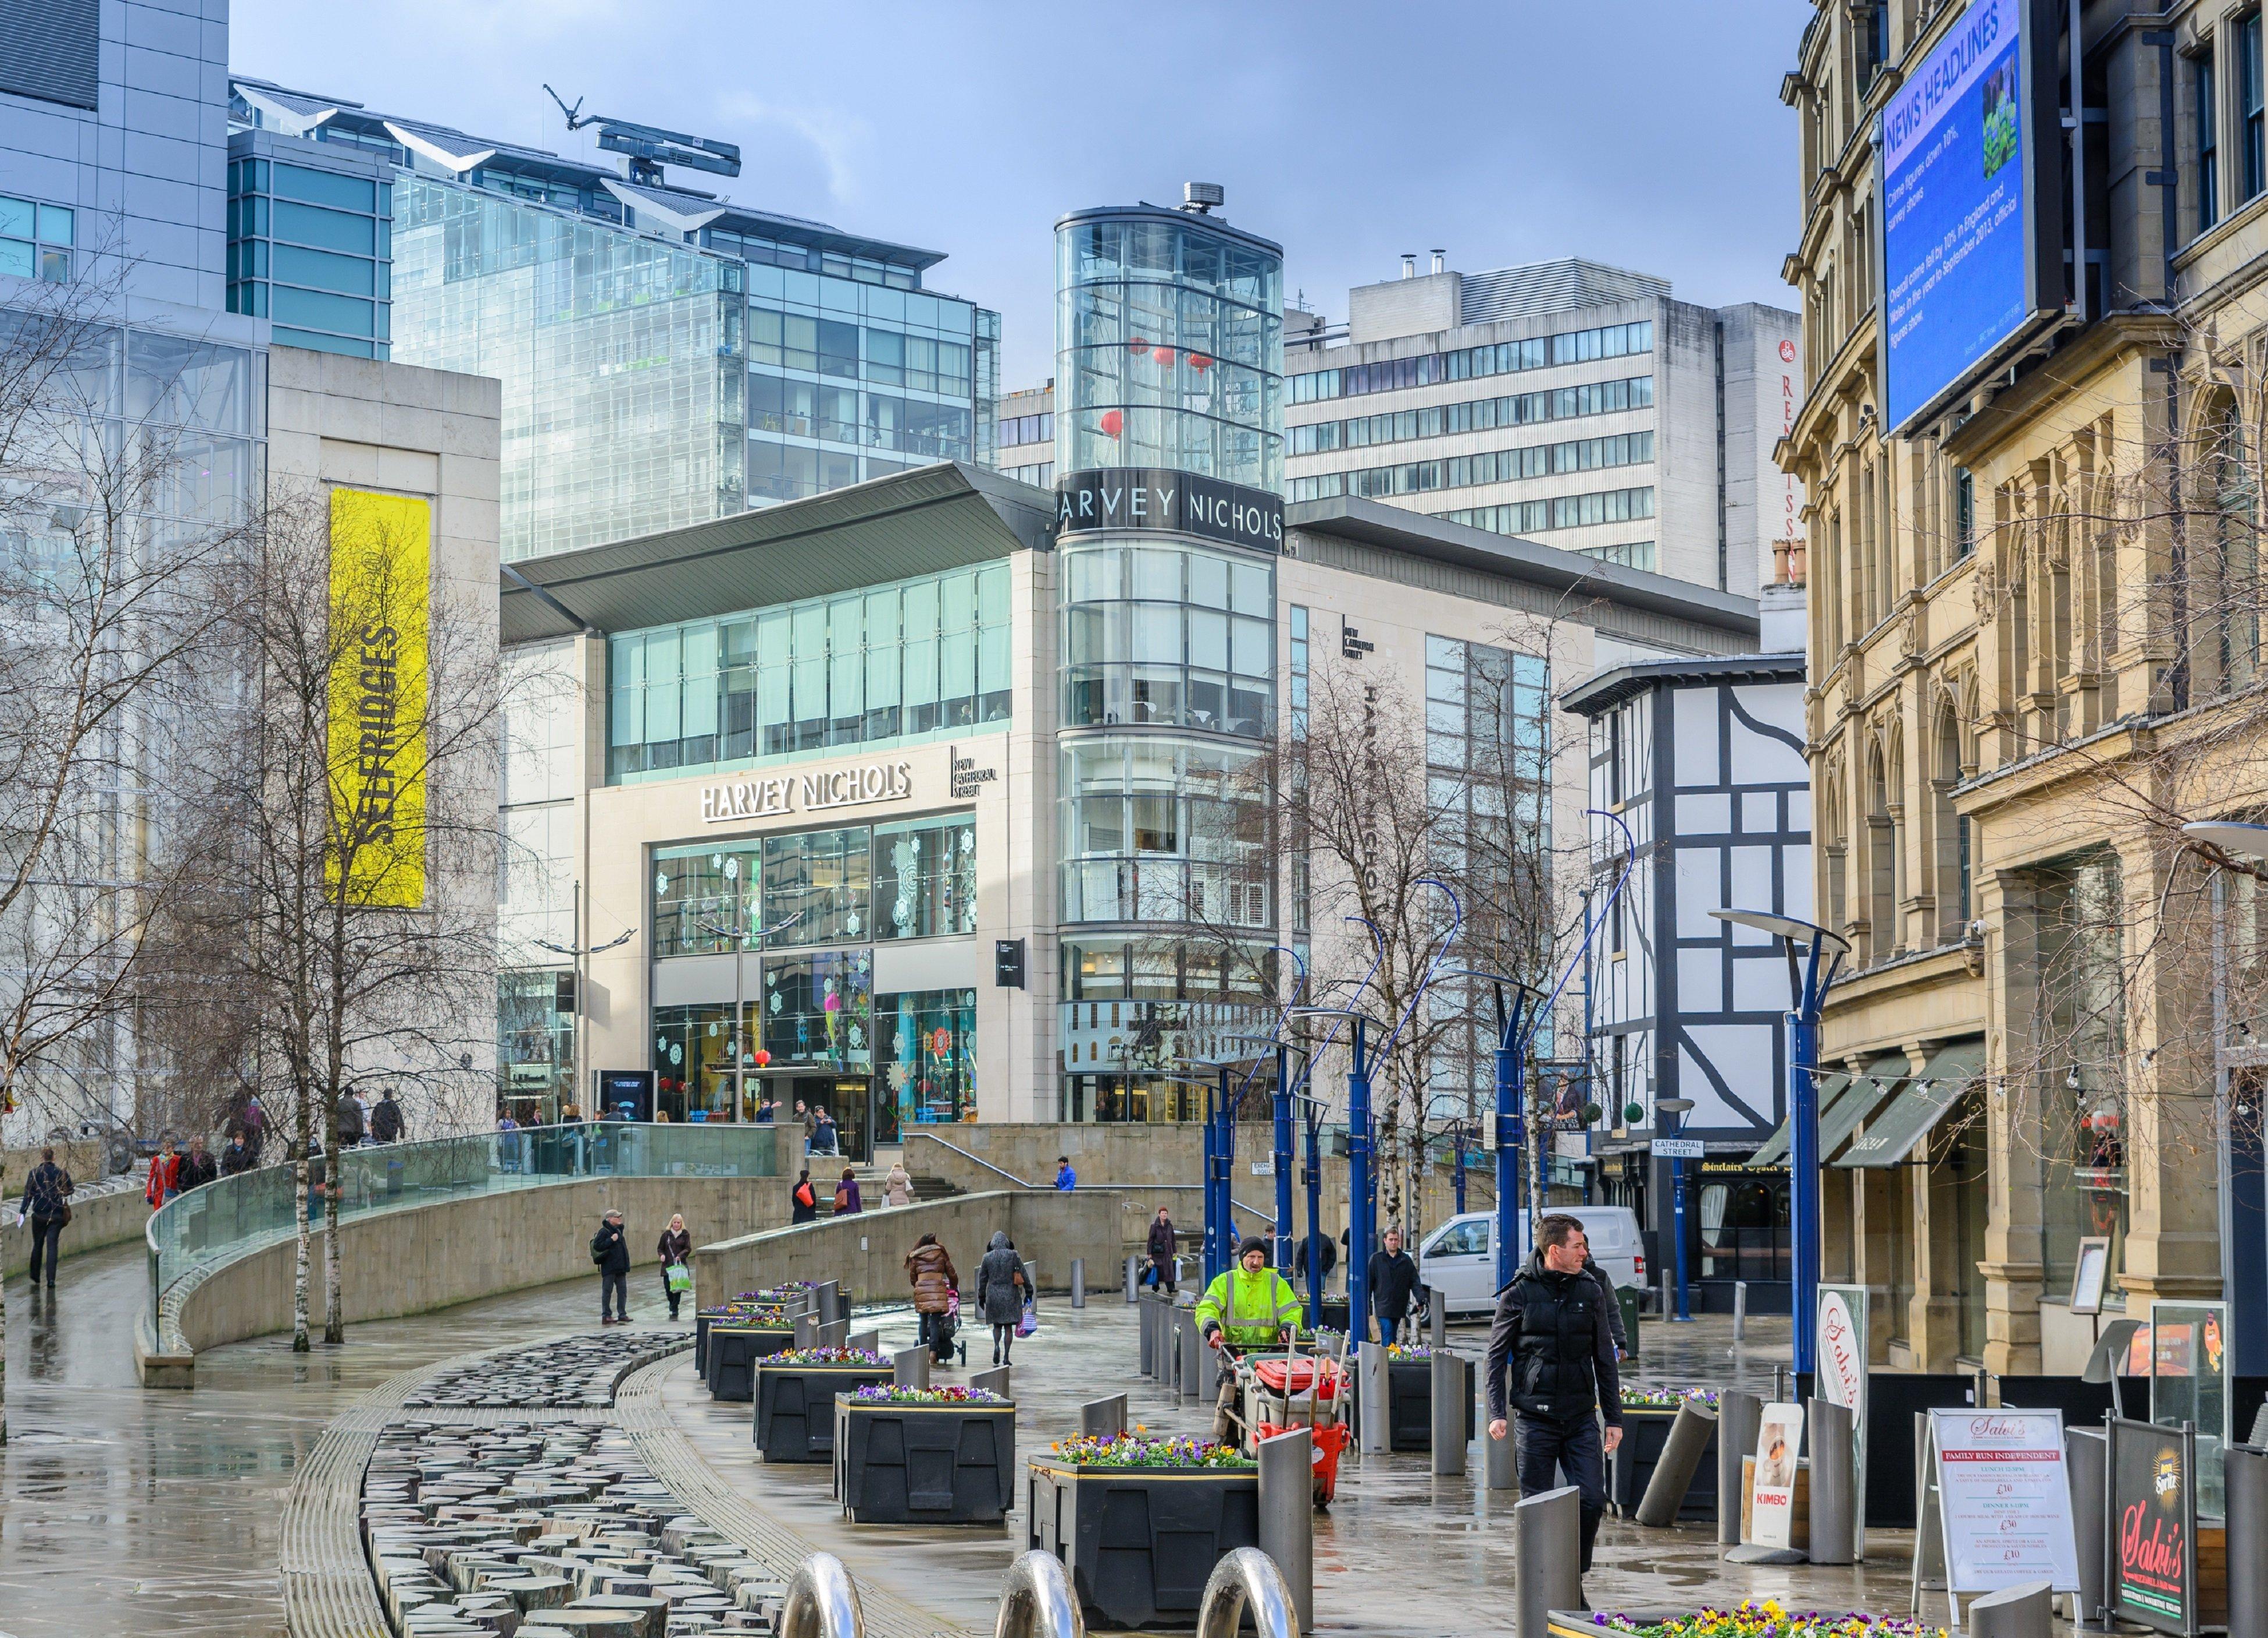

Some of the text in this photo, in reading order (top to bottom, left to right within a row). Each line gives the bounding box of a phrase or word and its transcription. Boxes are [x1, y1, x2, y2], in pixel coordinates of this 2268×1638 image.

[1887, 2, 1999, 159] NEWS HEADLINES
[1888, 183, 1905, 208] Crime
[1905, 162, 1924, 191] figures
[1925, 143, 1942, 168] down
[1888, 187, 1924, 233] survey shows
[1889, 180, 2004, 304] Overall crime fell by 10% in England and
[1890, 303, 1905, 326] Wales
[1906, 297, 1912, 311] in
[1912, 288, 1921, 305] the
[1922, 274, 1935, 298] year
[1935, 268, 1942, 283] to
[1942, 236, 1975, 276] September
[1994, 193, 2017, 226] official
[1891, 323, 1908, 349] figures
[1782, 375, 1795, 582] RENISS
[1190, 492, 1281, 540] NICHOLS
[1345, 627, 1358, 638] NEW
[1345, 638, 1375, 651] CATHEDRAL
[1345, 649, 1363, 660] STREET
[358, 626, 397, 845] SELFRIDGES
[954, 758, 973, 772] NEW
[954, 768, 997, 785] CATHEDRAL
[701, 762, 910, 818] HARVEY NICHOLS
[954, 785, 980, 799] STREET
[1364, 799, 1377, 910] NICHO
[1702, 1162, 1743, 1172] Sinclairs
[1824, 1308, 1857, 1404] Salvi's
[1970, 1416, 2025, 1440] Salvi's
[1996, 1484, 2012, 1494] £10
[2156, 1472, 2177, 1495] Spritz
[1757, 1493, 1787, 1505] KIMBO
[2000, 1520, 2016, 1530] £30
[2122, 1500, 2183, 1580] Salvi's
[2003, 1550, 2020, 1559] £10
